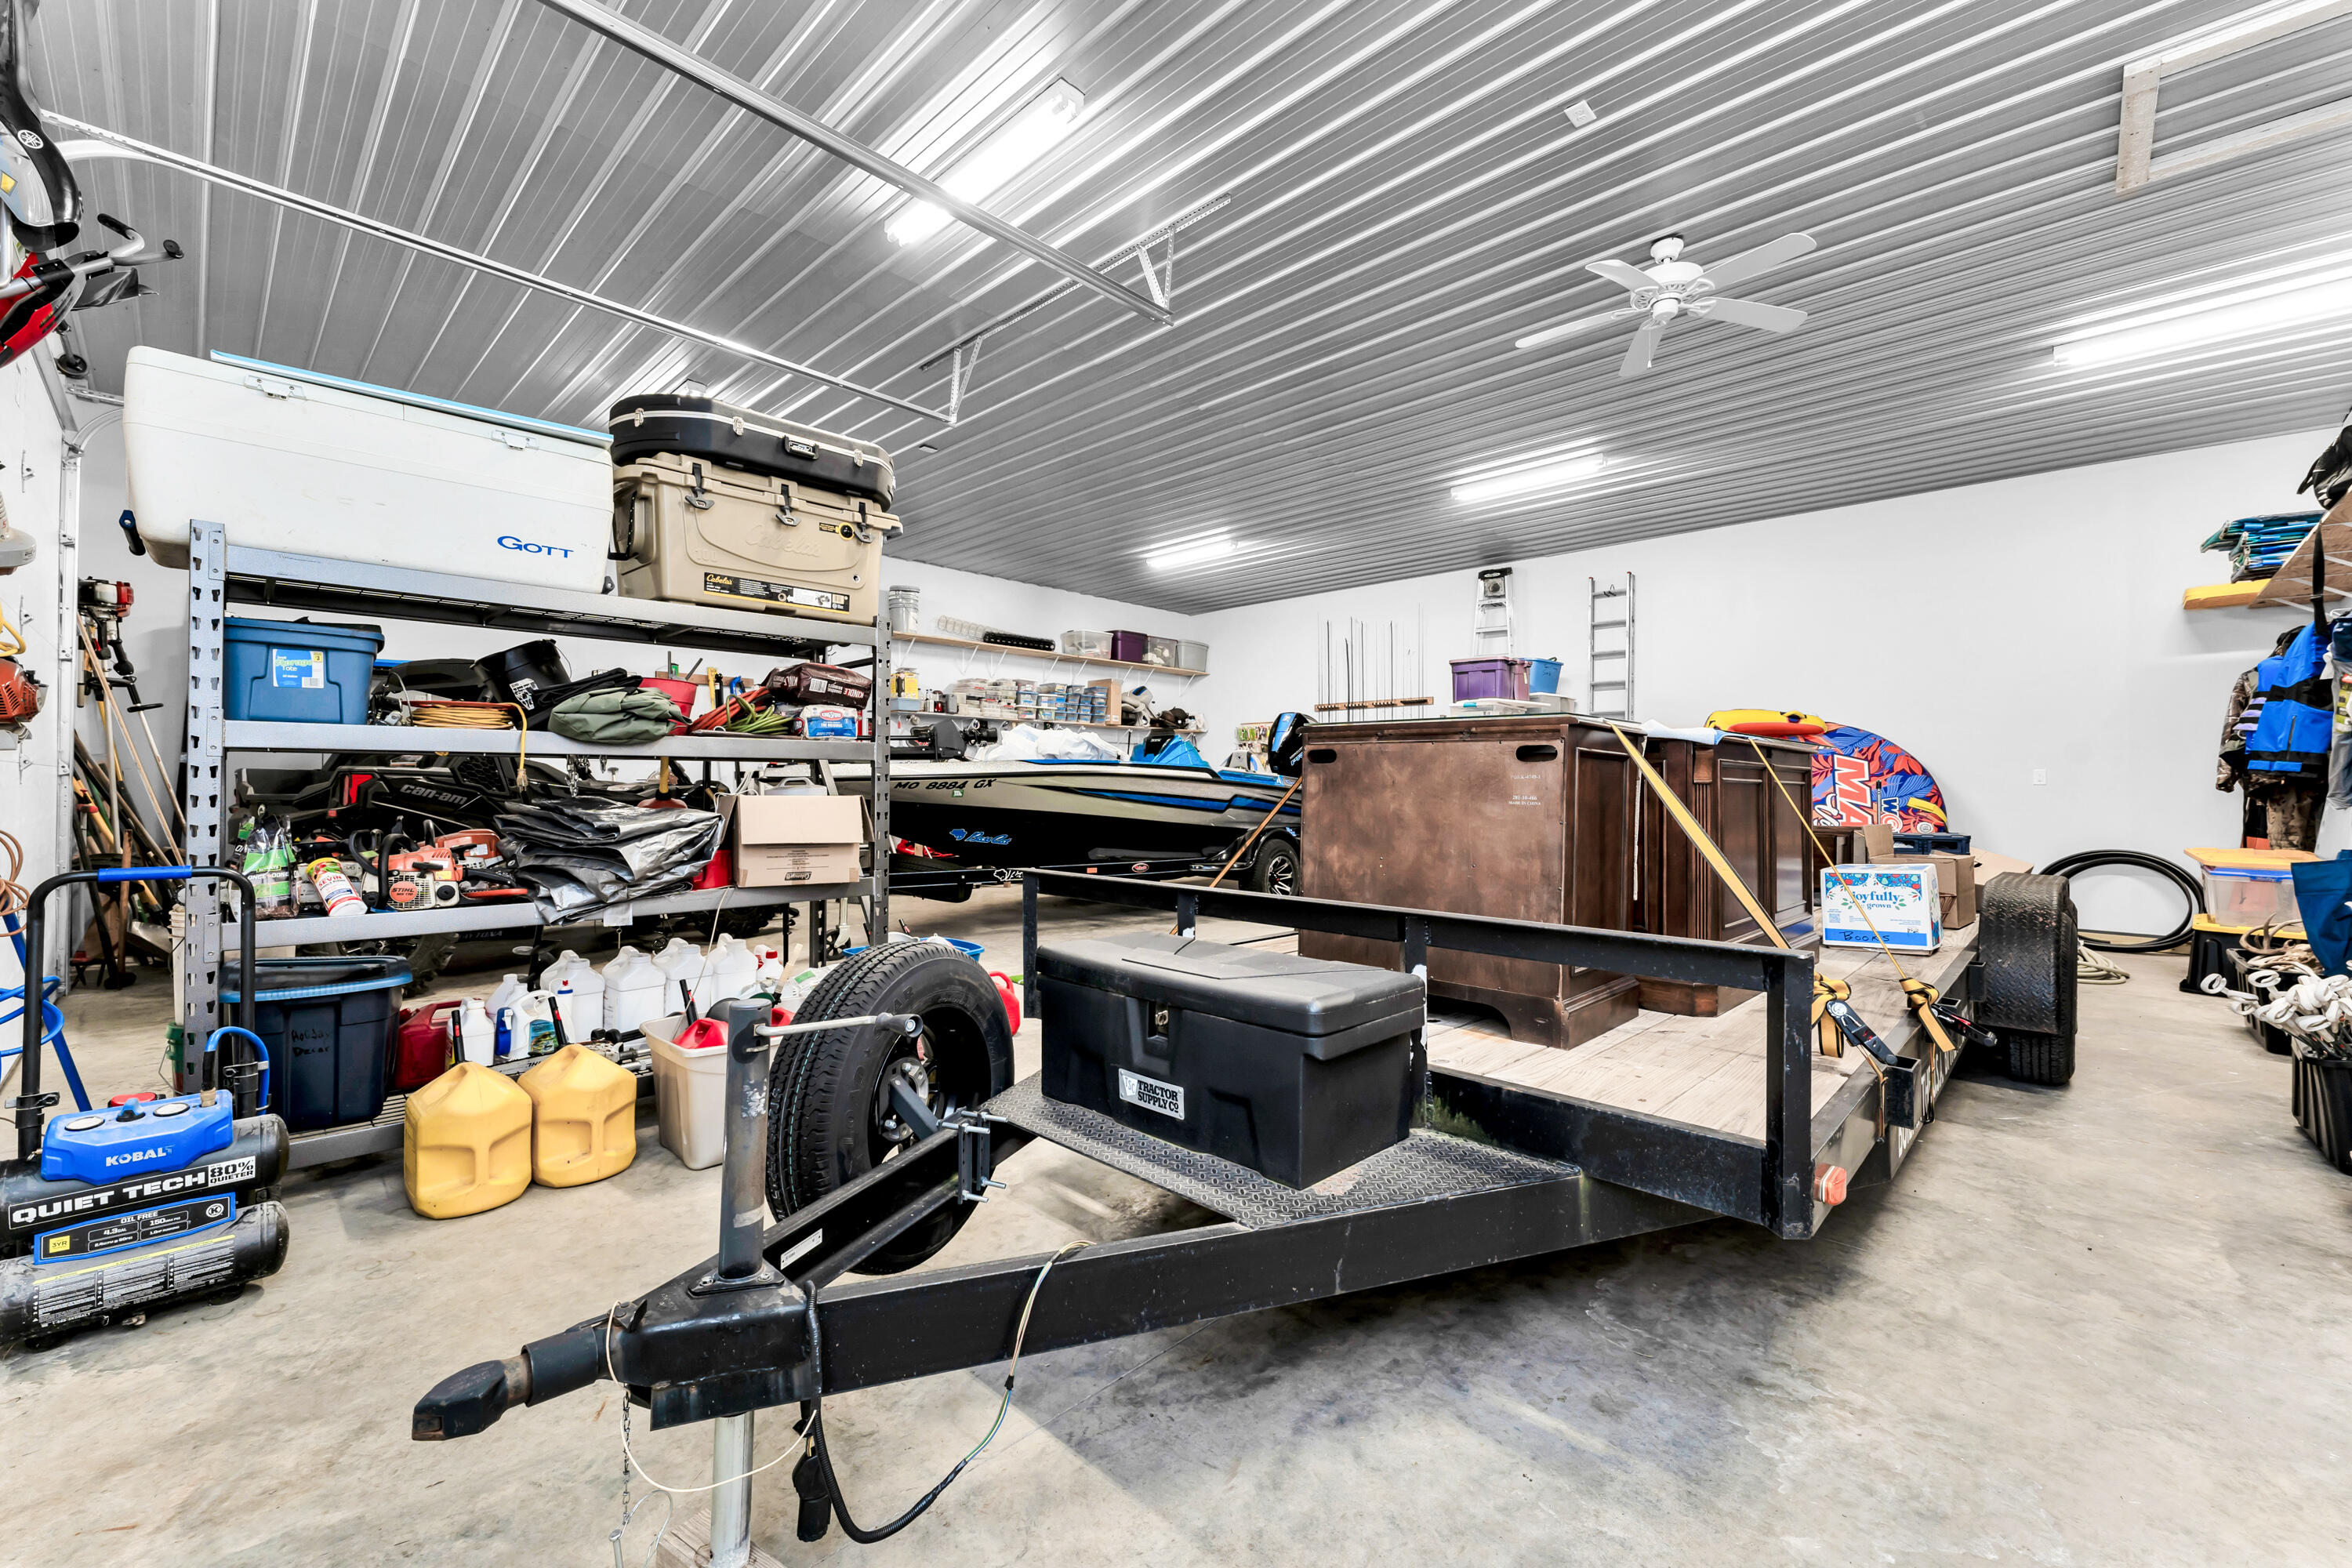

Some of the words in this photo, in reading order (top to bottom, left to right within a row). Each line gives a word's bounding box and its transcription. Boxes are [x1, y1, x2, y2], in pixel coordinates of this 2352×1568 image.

[926, 781, 968, 789] 8884
[973, 779, 996, 789] GX
[1138, 1080, 1178, 1102] TRACTOR
[1138, 1091, 1168, 1110] SUPPLY
[210, 1159, 255, 1178] 80%
[210, 1170, 254, 1185] QUIETER
[13, 1190, 115, 1224] QUIET
[122, 1171, 205, 1200] TECH
[137, 1211, 158, 1221] FREE
[50, 1240, 68, 1249] 3YR
